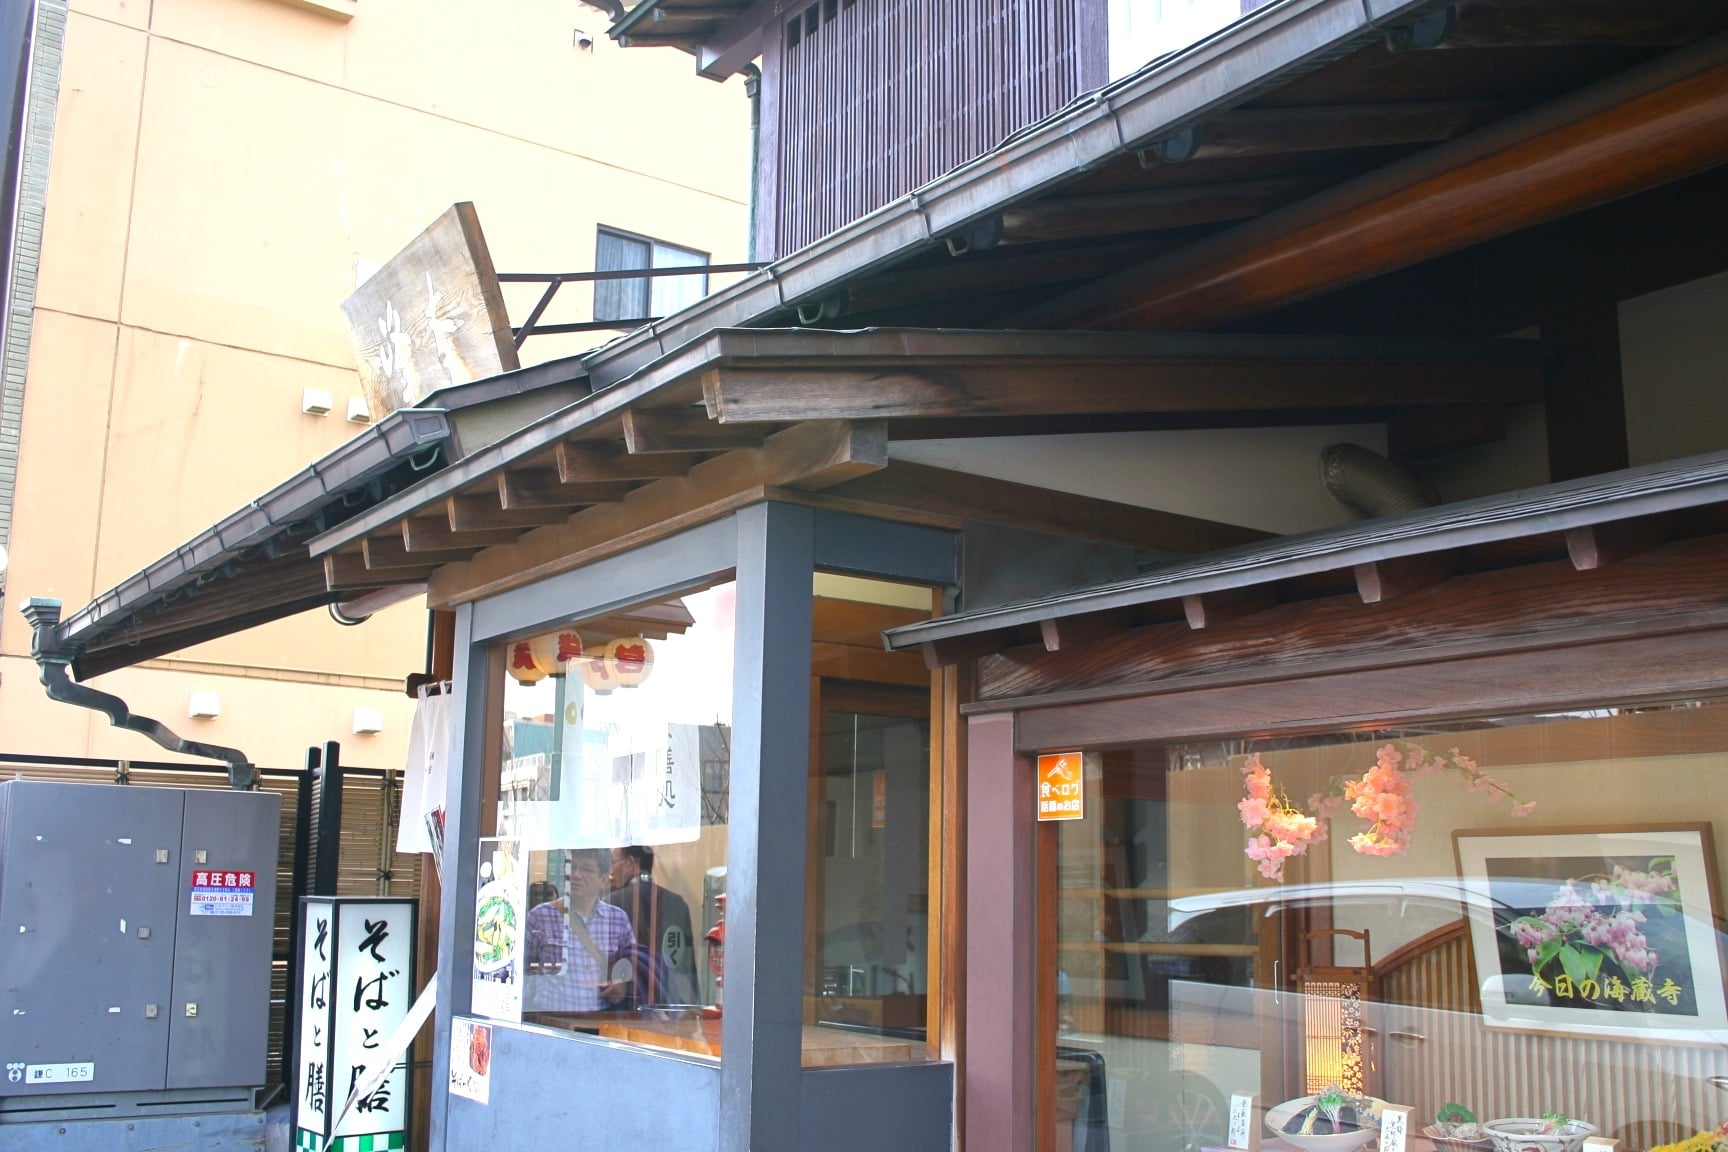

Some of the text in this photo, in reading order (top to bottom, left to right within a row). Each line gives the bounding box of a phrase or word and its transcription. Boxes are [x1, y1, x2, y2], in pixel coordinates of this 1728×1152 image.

[1041, 781, 1080, 798] 食べログ
[196, 872, 251, 887] 高圧危険
[667, 931, 680, 966] 引く
[1528, 972, 1682, 1006] 今日の海蔵寺
[67, 1066, 88, 1078] 165
